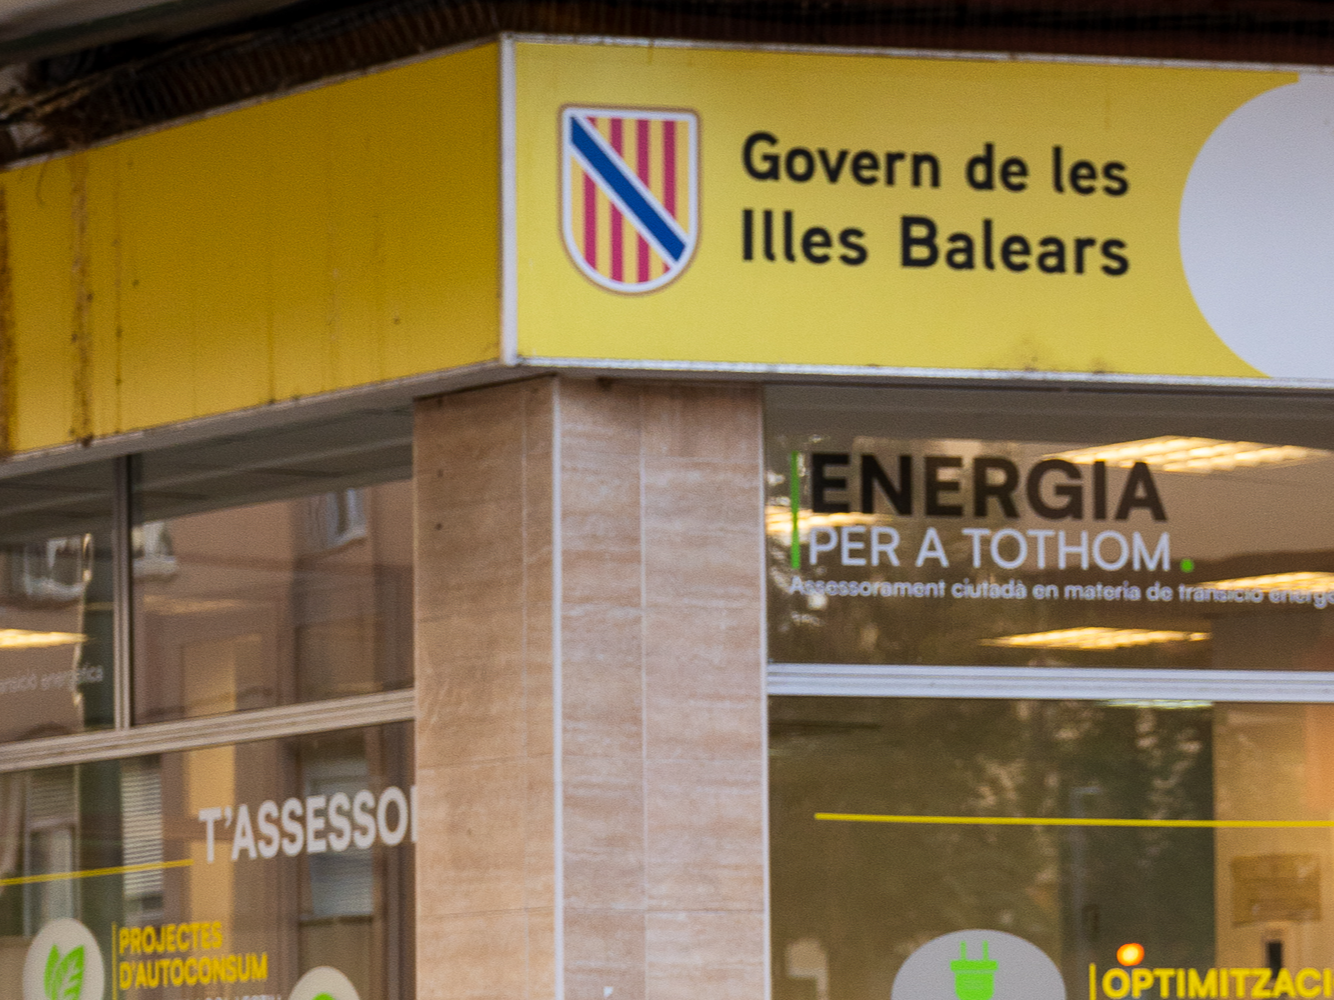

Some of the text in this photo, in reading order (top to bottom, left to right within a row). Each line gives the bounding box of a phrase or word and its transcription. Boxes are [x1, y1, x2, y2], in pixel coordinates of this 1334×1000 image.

[741, 131, 1129, 197] Govern de les
[741, 208, 1130, 276] Illes Balears
[810, 452, 1168, 522] ENERGIA
[809, 526, 900, 567] PER
[915, 527, 949, 568] A
[789, 575, 946, 598] Assessorament
[1032, 583, 1059, 600] en
[1146, 581, 1173, 601] de
[119, 921, 223, 955] PROJECTES
[119, 952, 268, 990] D'AUTOCONSUM
